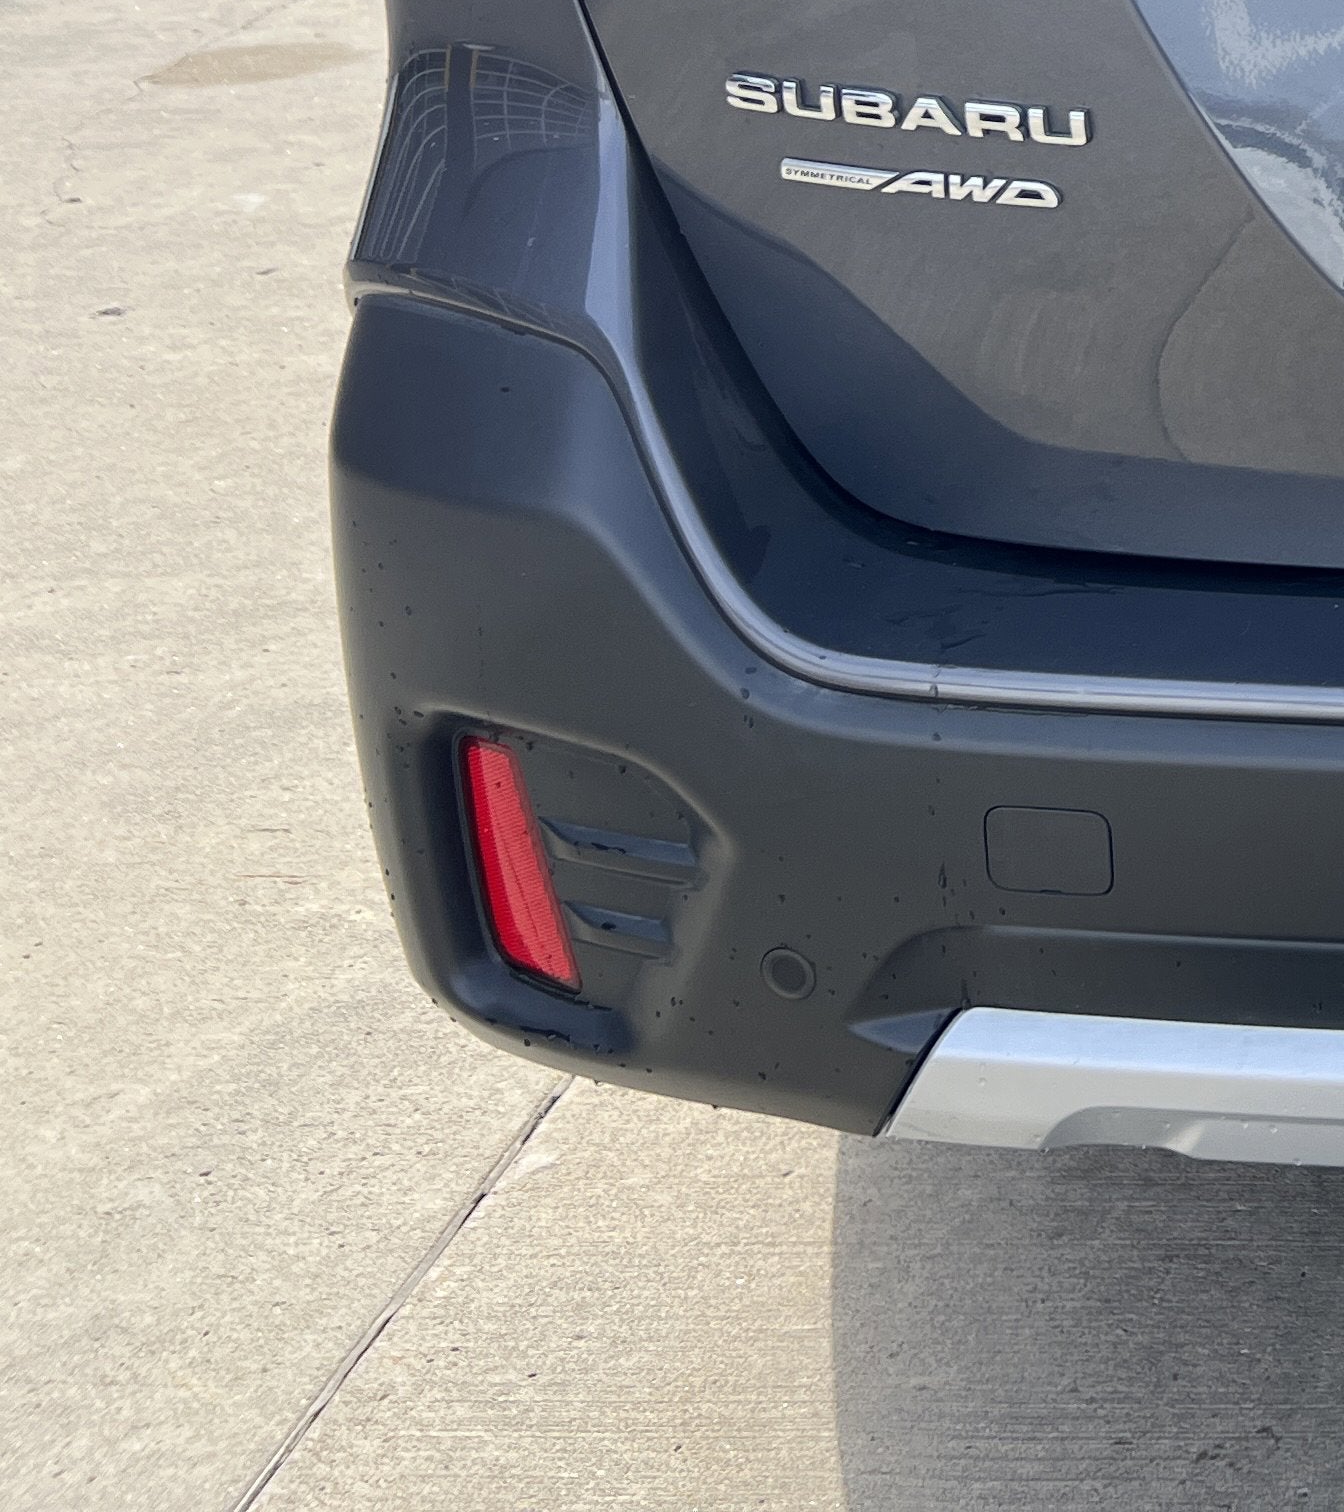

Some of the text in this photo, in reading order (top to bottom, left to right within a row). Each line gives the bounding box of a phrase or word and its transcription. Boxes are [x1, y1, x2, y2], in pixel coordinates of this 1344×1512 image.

[725, 71, 1092, 147] SUBARU
[784, 167, 1062, 209] SYMMETRICAL AWD
